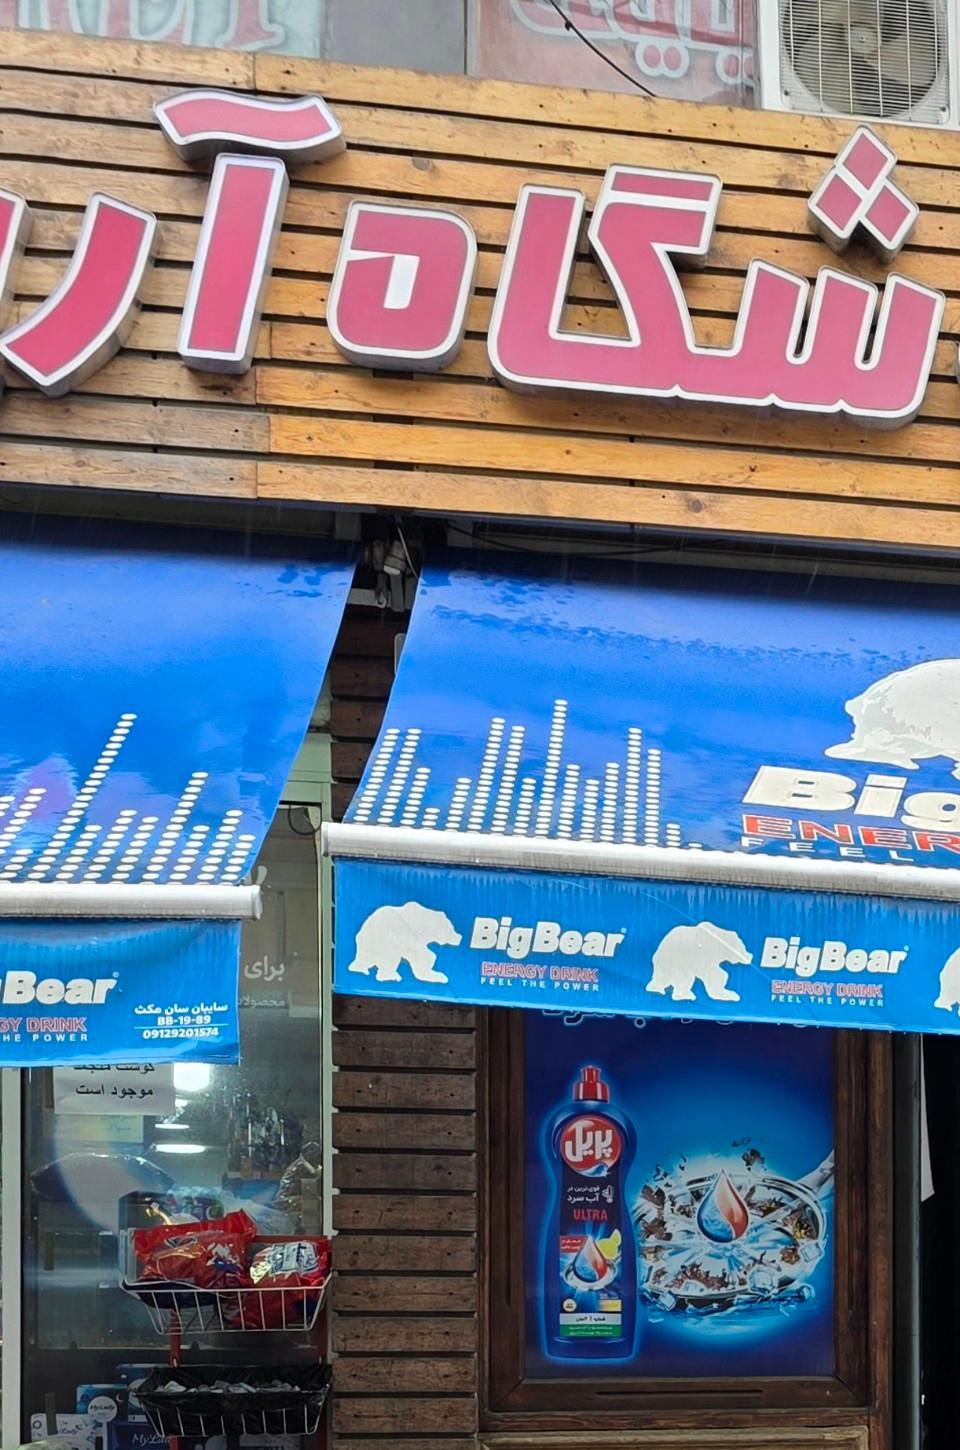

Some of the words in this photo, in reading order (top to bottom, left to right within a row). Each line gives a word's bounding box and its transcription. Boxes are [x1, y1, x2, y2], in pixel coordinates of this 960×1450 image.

[741, 836, 914, 862] FEEL
[470, 916, 626, 959] BigBear
[760, 936, 908, 977] BigBear
[244, 955, 285, 981] برای
[481, 961, 548, 979] ENERGY
[550, 965, 599, 983] DRINK
[0, 970, 118, 1005] Bear
[480, 977, 513, 987] FEEL
[522, 979, 545, 989] THE
[555, 982, 600, 992] POWER
[771, 979, 834, 996] ENERGY
[836, 982, 883, 998] DRINK
[771, 994, 801, 1004] FEEL
[810, 996, 833, 1005] THE
[841, 998, 884, 1007] POWER
[26, 1017, 88, 1032] DRINK
[33, 1033, 88, 1042] POWER
[76, 1083, 104, 1095] است
[111, 1085, 153, 1099] موجود
[565, 1120, 613, 1162] پریل
[573, 1208, 608, 1220] ULTRA
